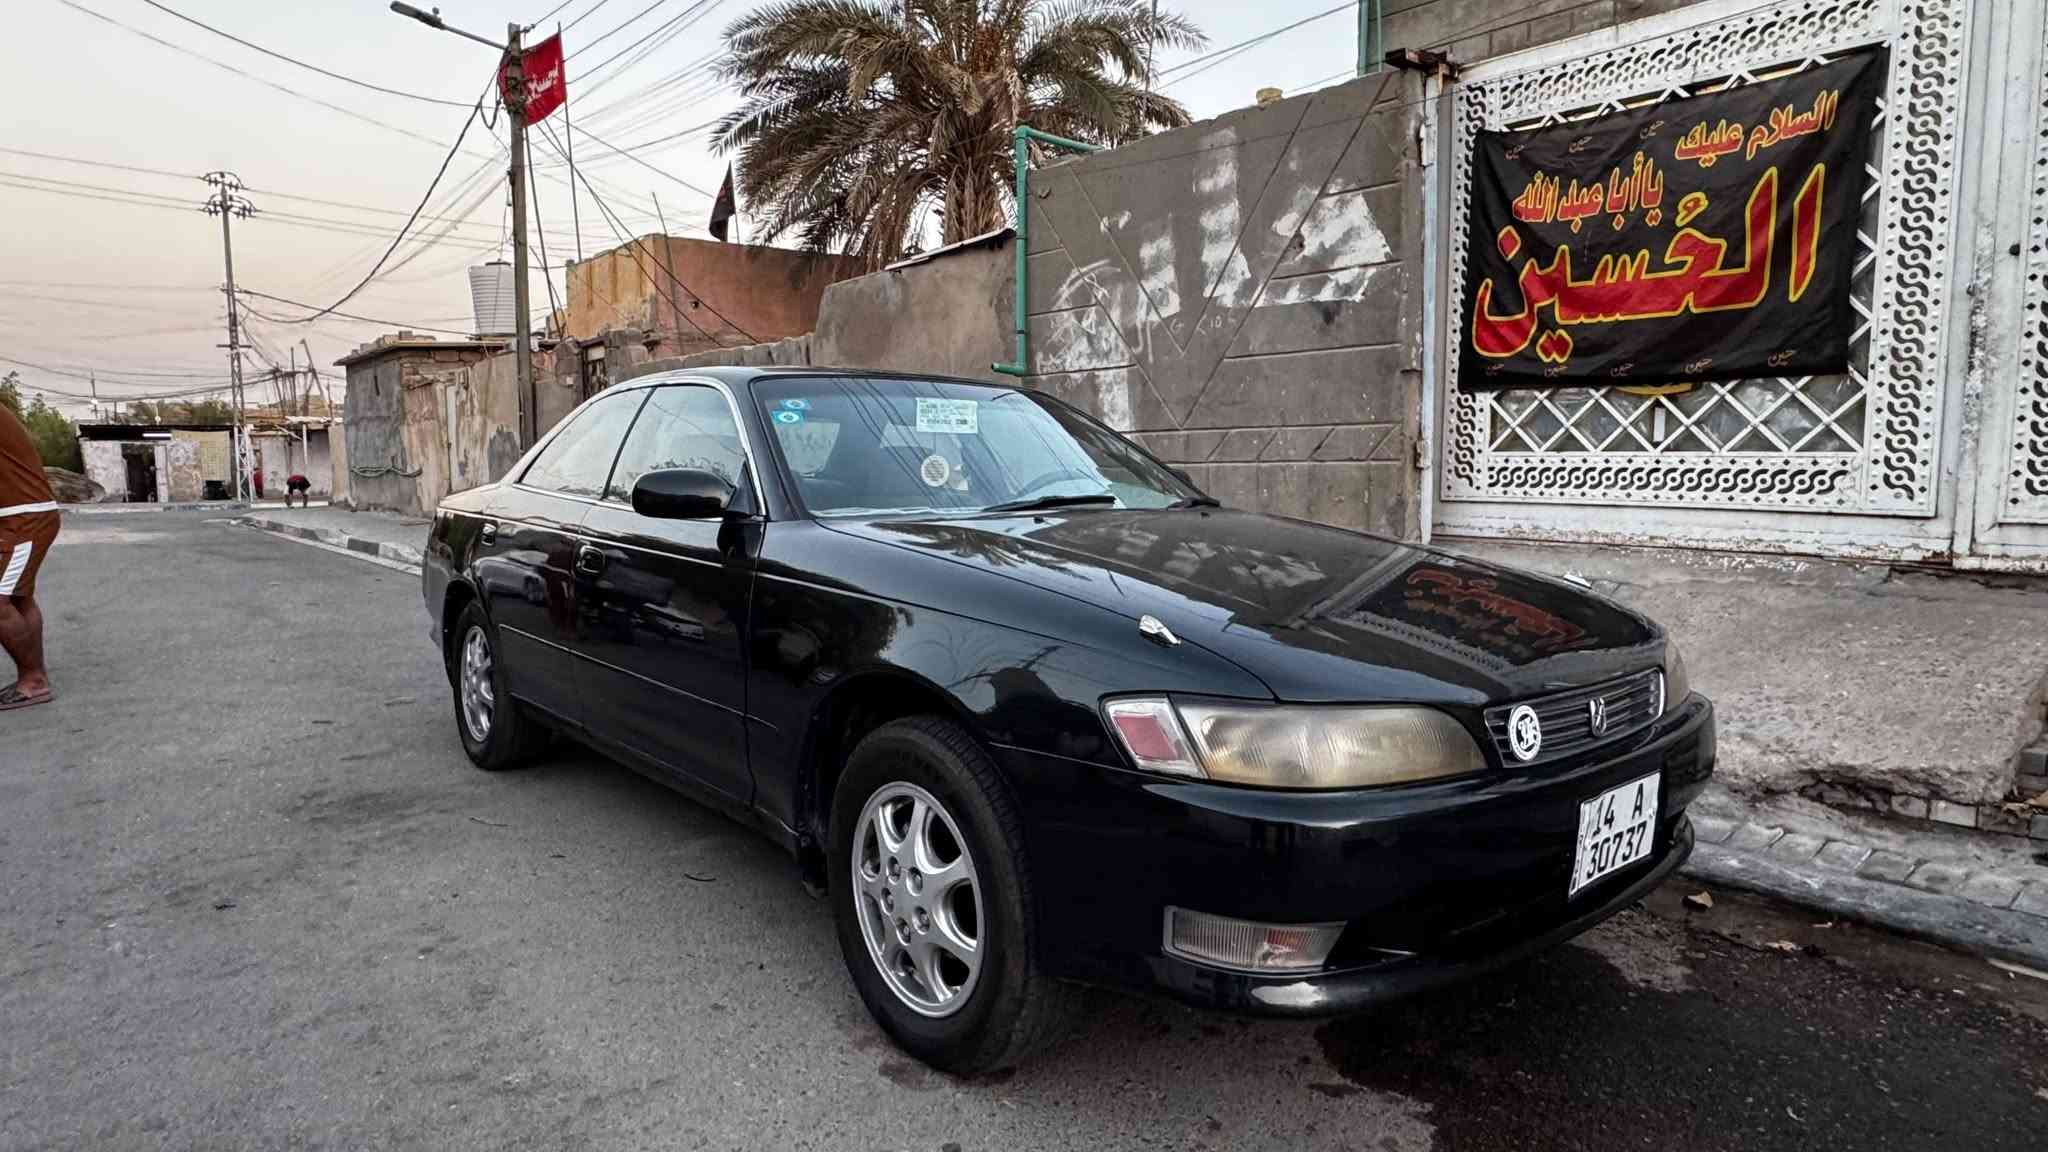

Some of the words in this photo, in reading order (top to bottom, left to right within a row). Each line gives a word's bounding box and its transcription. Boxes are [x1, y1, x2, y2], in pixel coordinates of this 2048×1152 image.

[1675, 119, 1744, 167] عليك
[1746, 90, 1838, 160] السلام
[1512, 170, 1559, 223] الله
[1557, 179, 1604, 234] عبد
[1592, 794, 1616, 837] 14
[1632, 782, 1644, 820] A
[1586, 820, 1648, 879] 30737
